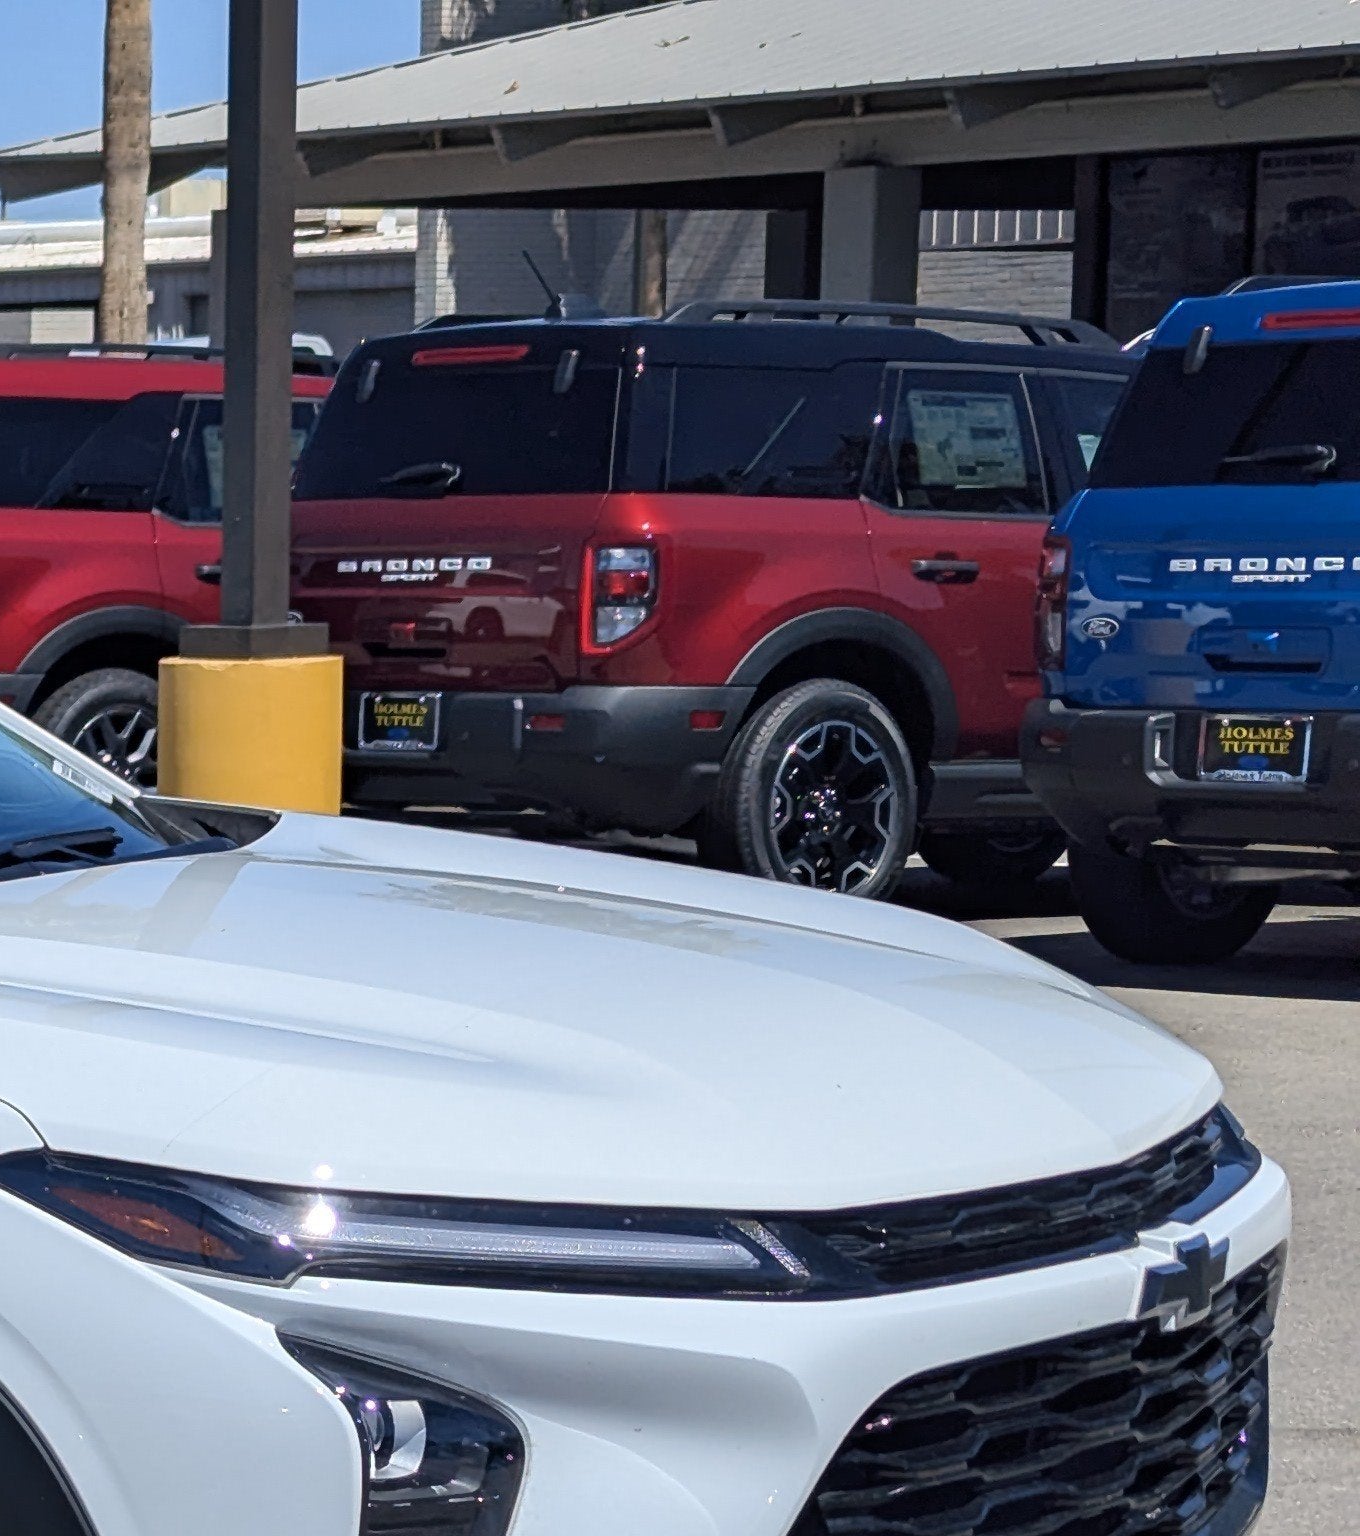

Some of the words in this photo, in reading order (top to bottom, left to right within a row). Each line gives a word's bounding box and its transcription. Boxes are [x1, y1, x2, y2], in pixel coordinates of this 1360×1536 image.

[337, 557, 492, 572] BRONCO
[1169, 556, 1360, 573] BRONC
[380, 573, 439, 583] SPORT
[1231, 573, 1312, 584] SPORT
[374, 703, 428, 714] HOLMES
[375, 715, 424, 727] TUTTLE
[1219, 727, 1294, 740] HOLMES
[1220, 740, 1290, 755] TUTTLE
